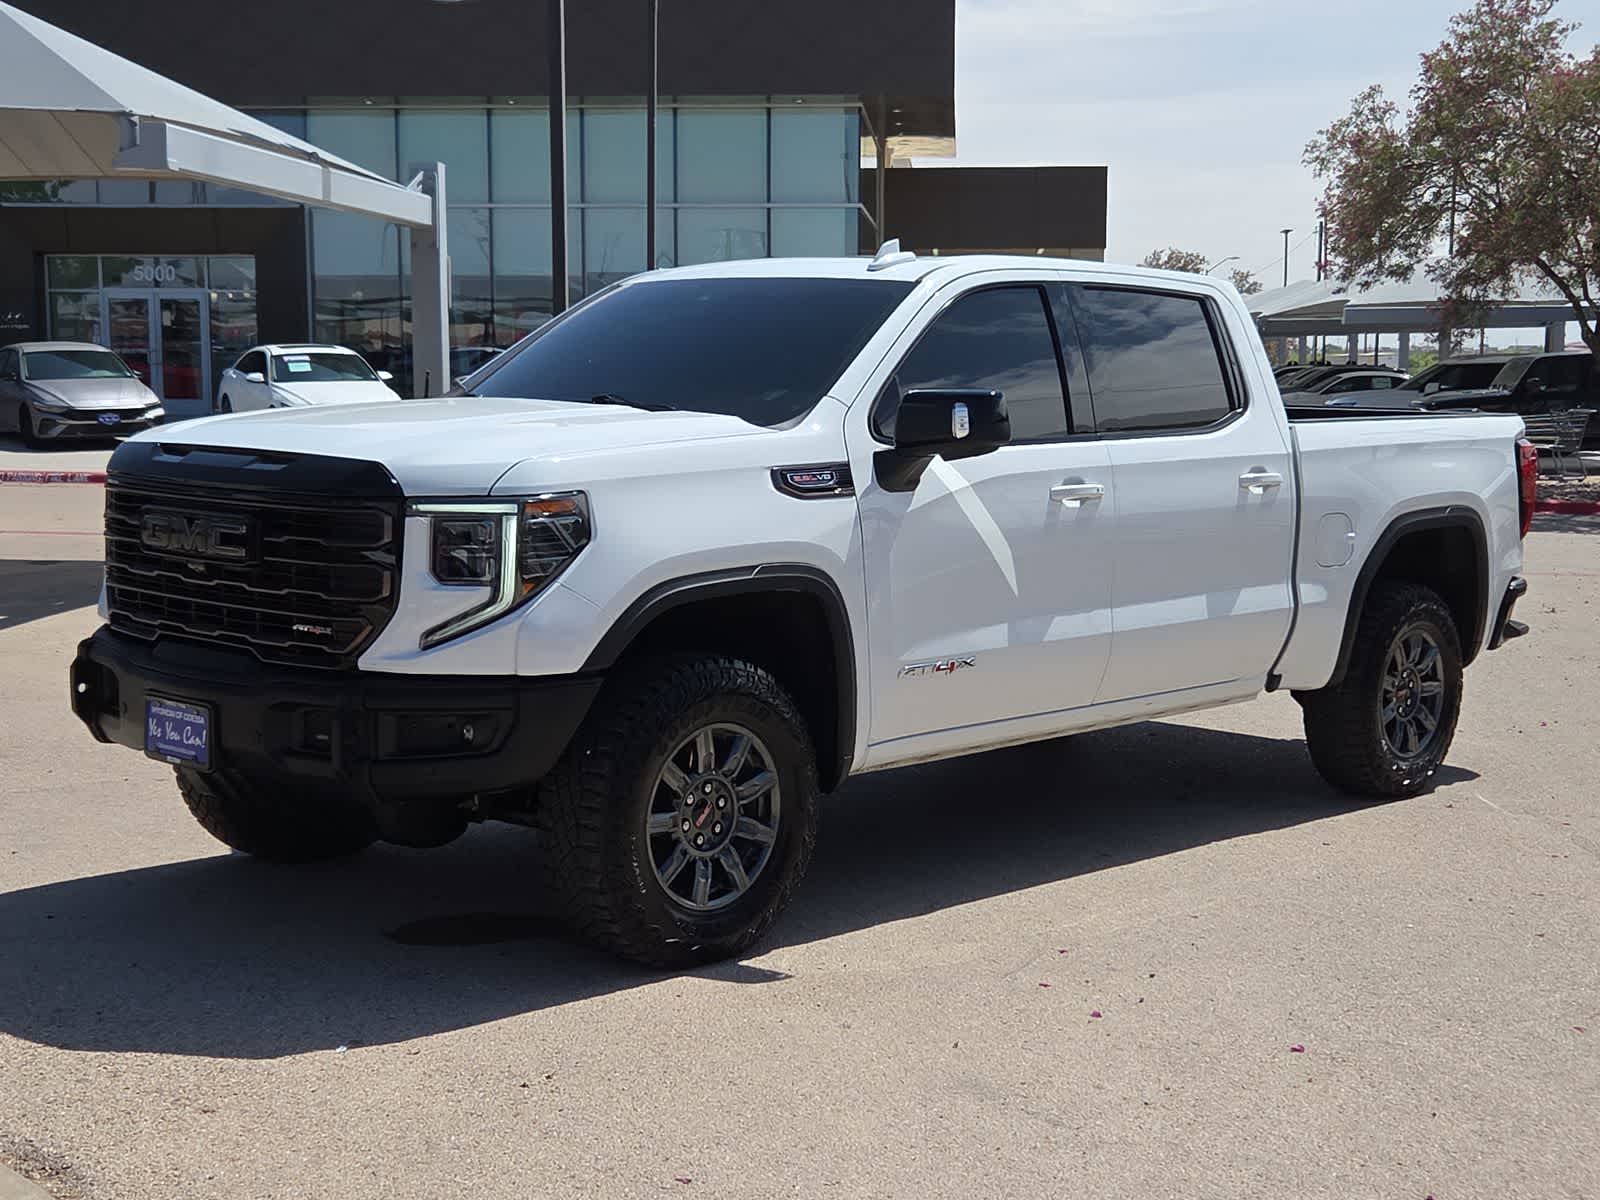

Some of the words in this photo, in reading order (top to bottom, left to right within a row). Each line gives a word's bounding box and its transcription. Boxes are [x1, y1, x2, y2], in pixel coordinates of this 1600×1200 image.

[134, 265, 176, 281] 5000
[141, 513, 248, 559] GMC
[149, 717, 162, 738] Yes
[165, 721, 181, 741] You
[183, 726, 207, 749] Can!
